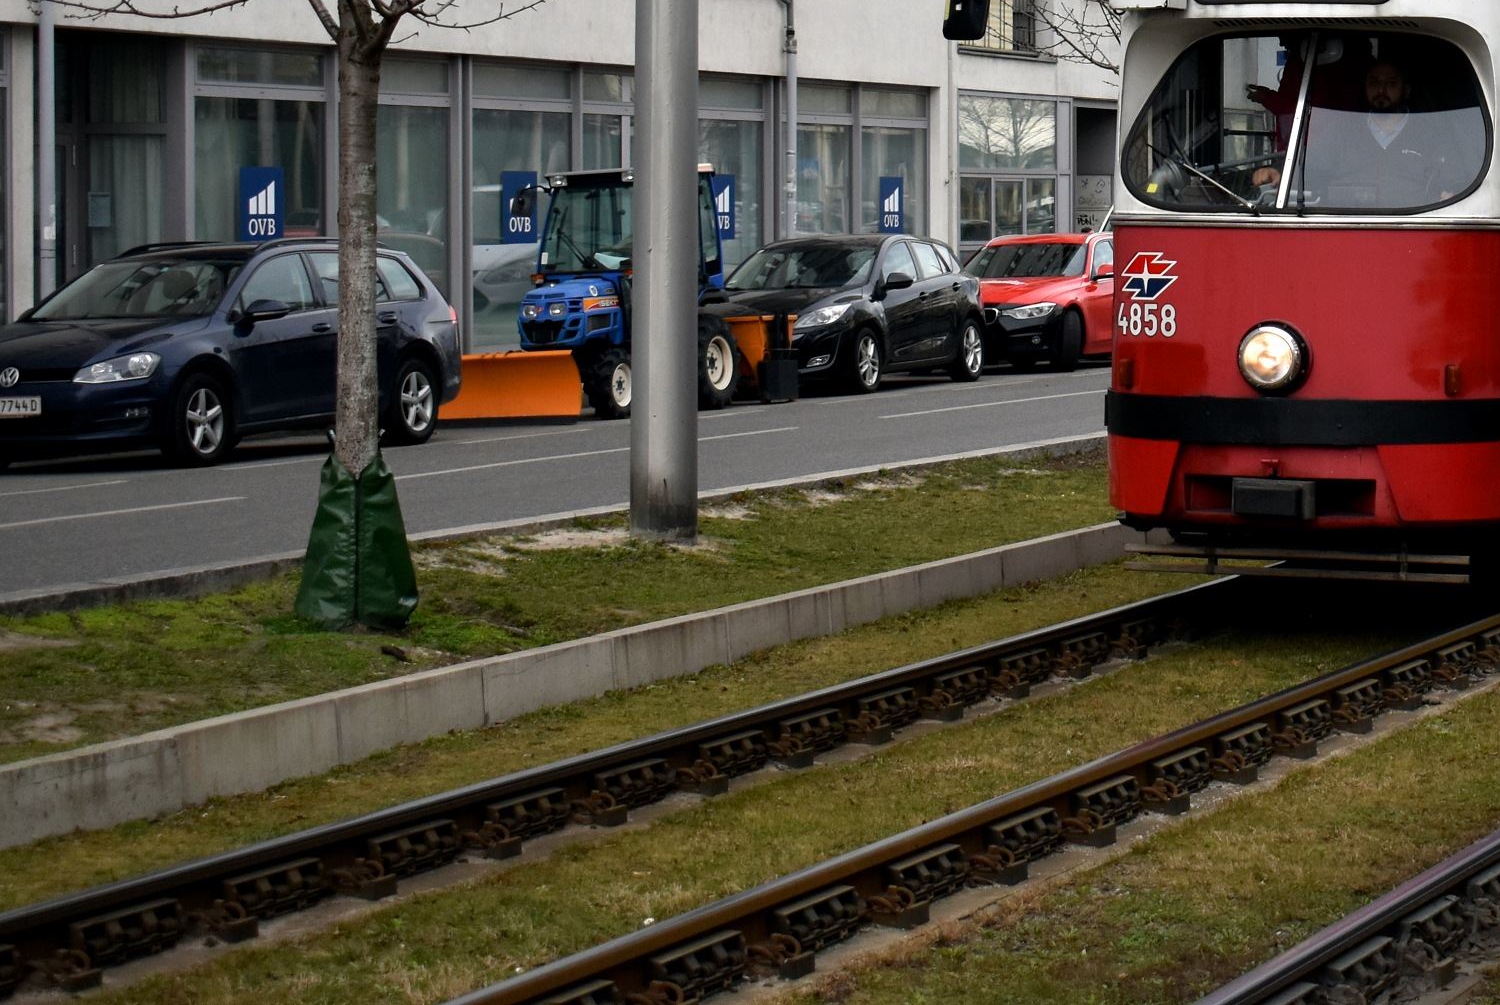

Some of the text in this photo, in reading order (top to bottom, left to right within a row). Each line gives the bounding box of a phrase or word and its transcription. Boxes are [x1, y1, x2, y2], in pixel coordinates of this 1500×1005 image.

[248, 218, 276, 236] OVB
[509, 216, 532, 233] OVB
[718, 216, 730, 229] VB
[883, 214, 900, 228] OVB
[1117, 302, 1177, 337] 4858
